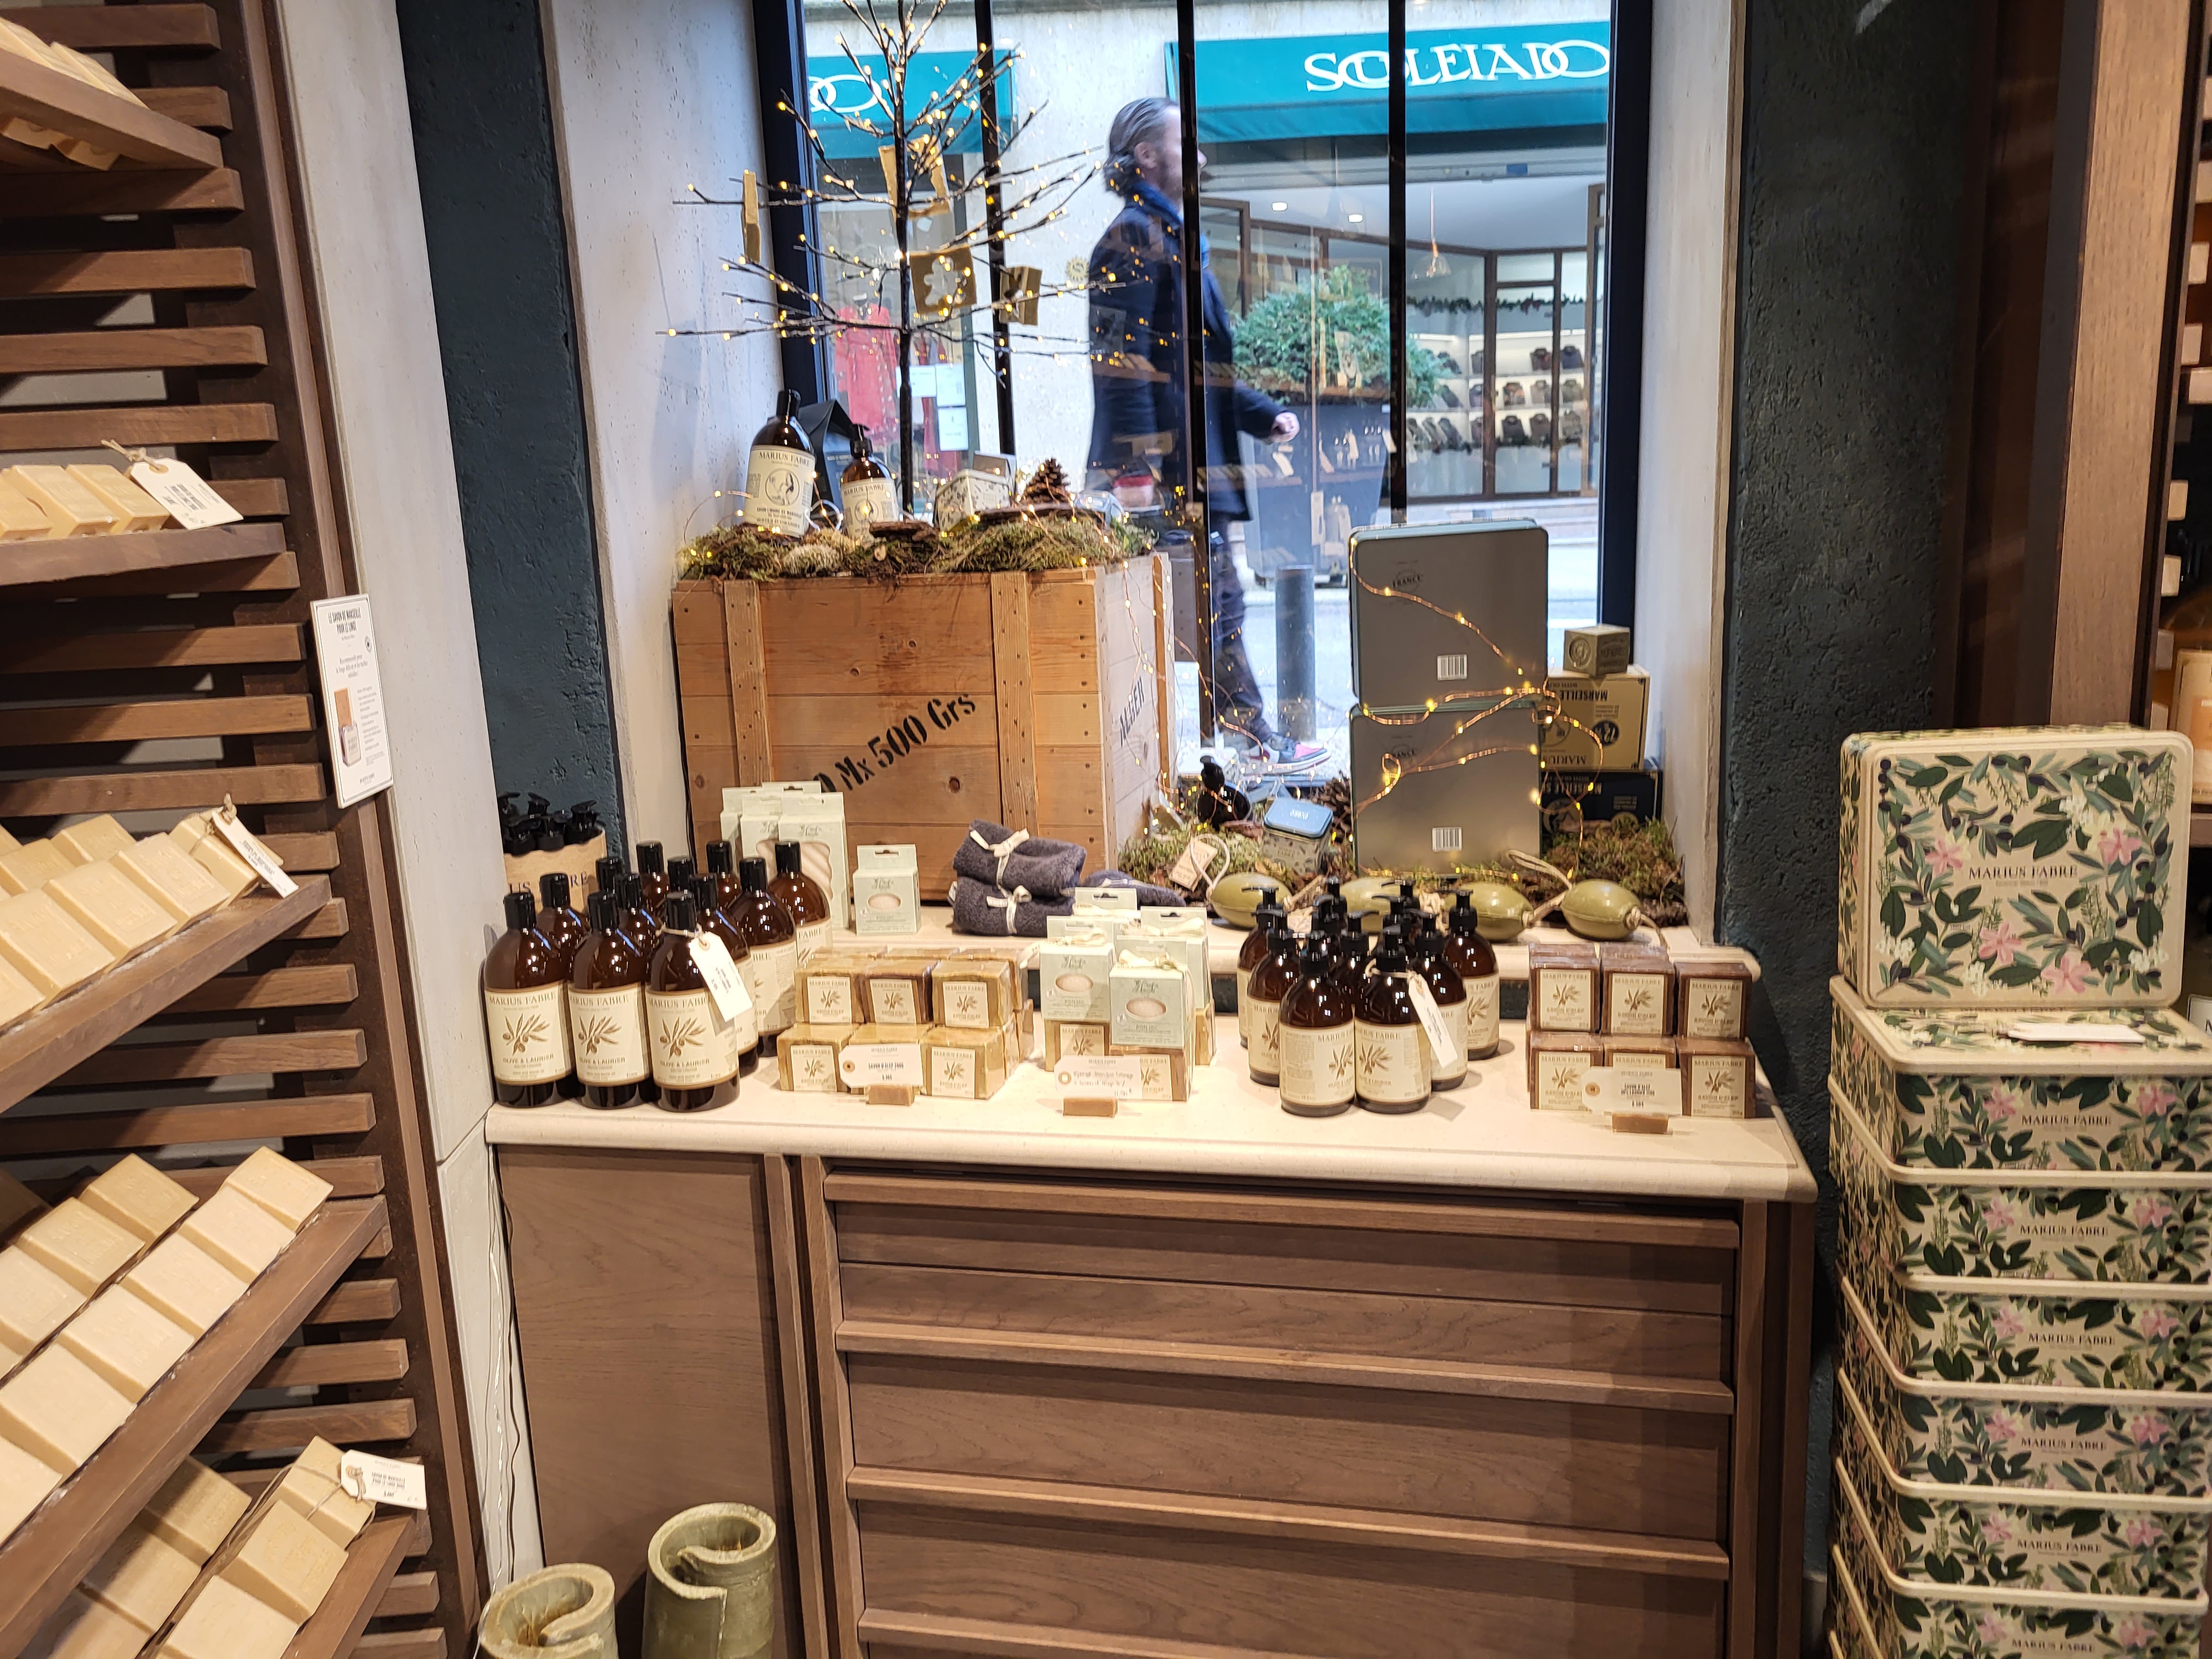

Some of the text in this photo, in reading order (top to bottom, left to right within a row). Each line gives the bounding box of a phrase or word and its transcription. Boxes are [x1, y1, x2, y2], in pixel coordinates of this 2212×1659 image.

[868, 714, 928, 768] 500
[927, 694, 976, 731] Grs
[1969, 864, 2078, 880] MARIUS FABRE
[489, 992, 556, 1006] MARIUS FABRE
[2022, 1114, 2112, 1127] MARIUS FABRE
[2020, 1224, 2109, 1237] MARIUS FABRE
[2028, 1332, 2115, 1346] MARIUS FABRE
[2021, 1437, 2107, 1452] MARIUS FABRE
[2017, 1538, 2102, 1553] MARIUS FABRE
[2011, 1638, 2096, 1653] MARIUS FABRE
